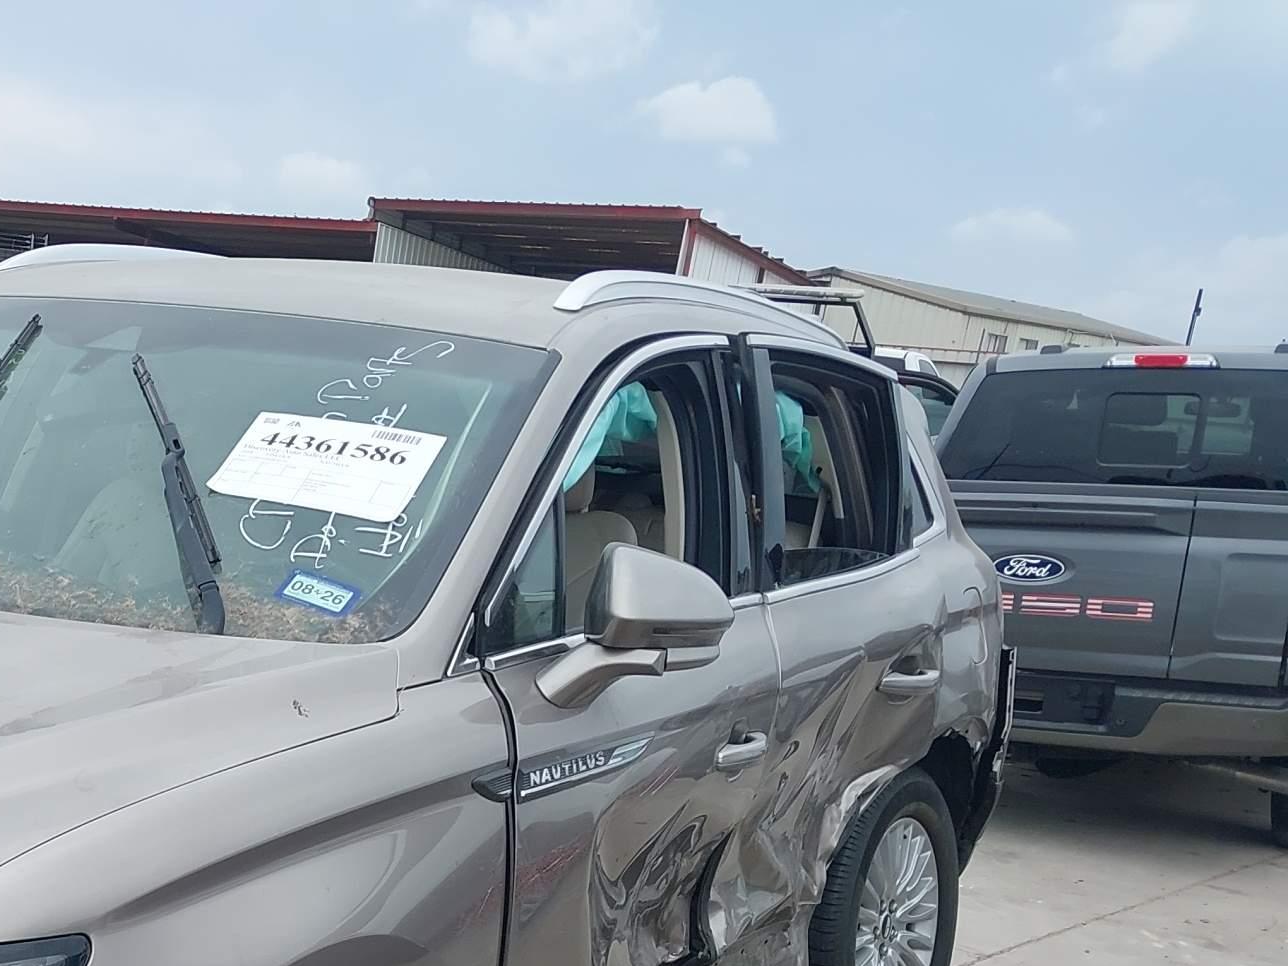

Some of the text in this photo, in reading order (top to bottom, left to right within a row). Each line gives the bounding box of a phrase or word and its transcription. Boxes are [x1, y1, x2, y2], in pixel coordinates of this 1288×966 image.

[260, 431, 411, 466] 44361586
[1003, 557, 1053, 578] Ford
[290, 580, 346, 606] 08 26
[530, 750, 606, 787] NAUTILUS
